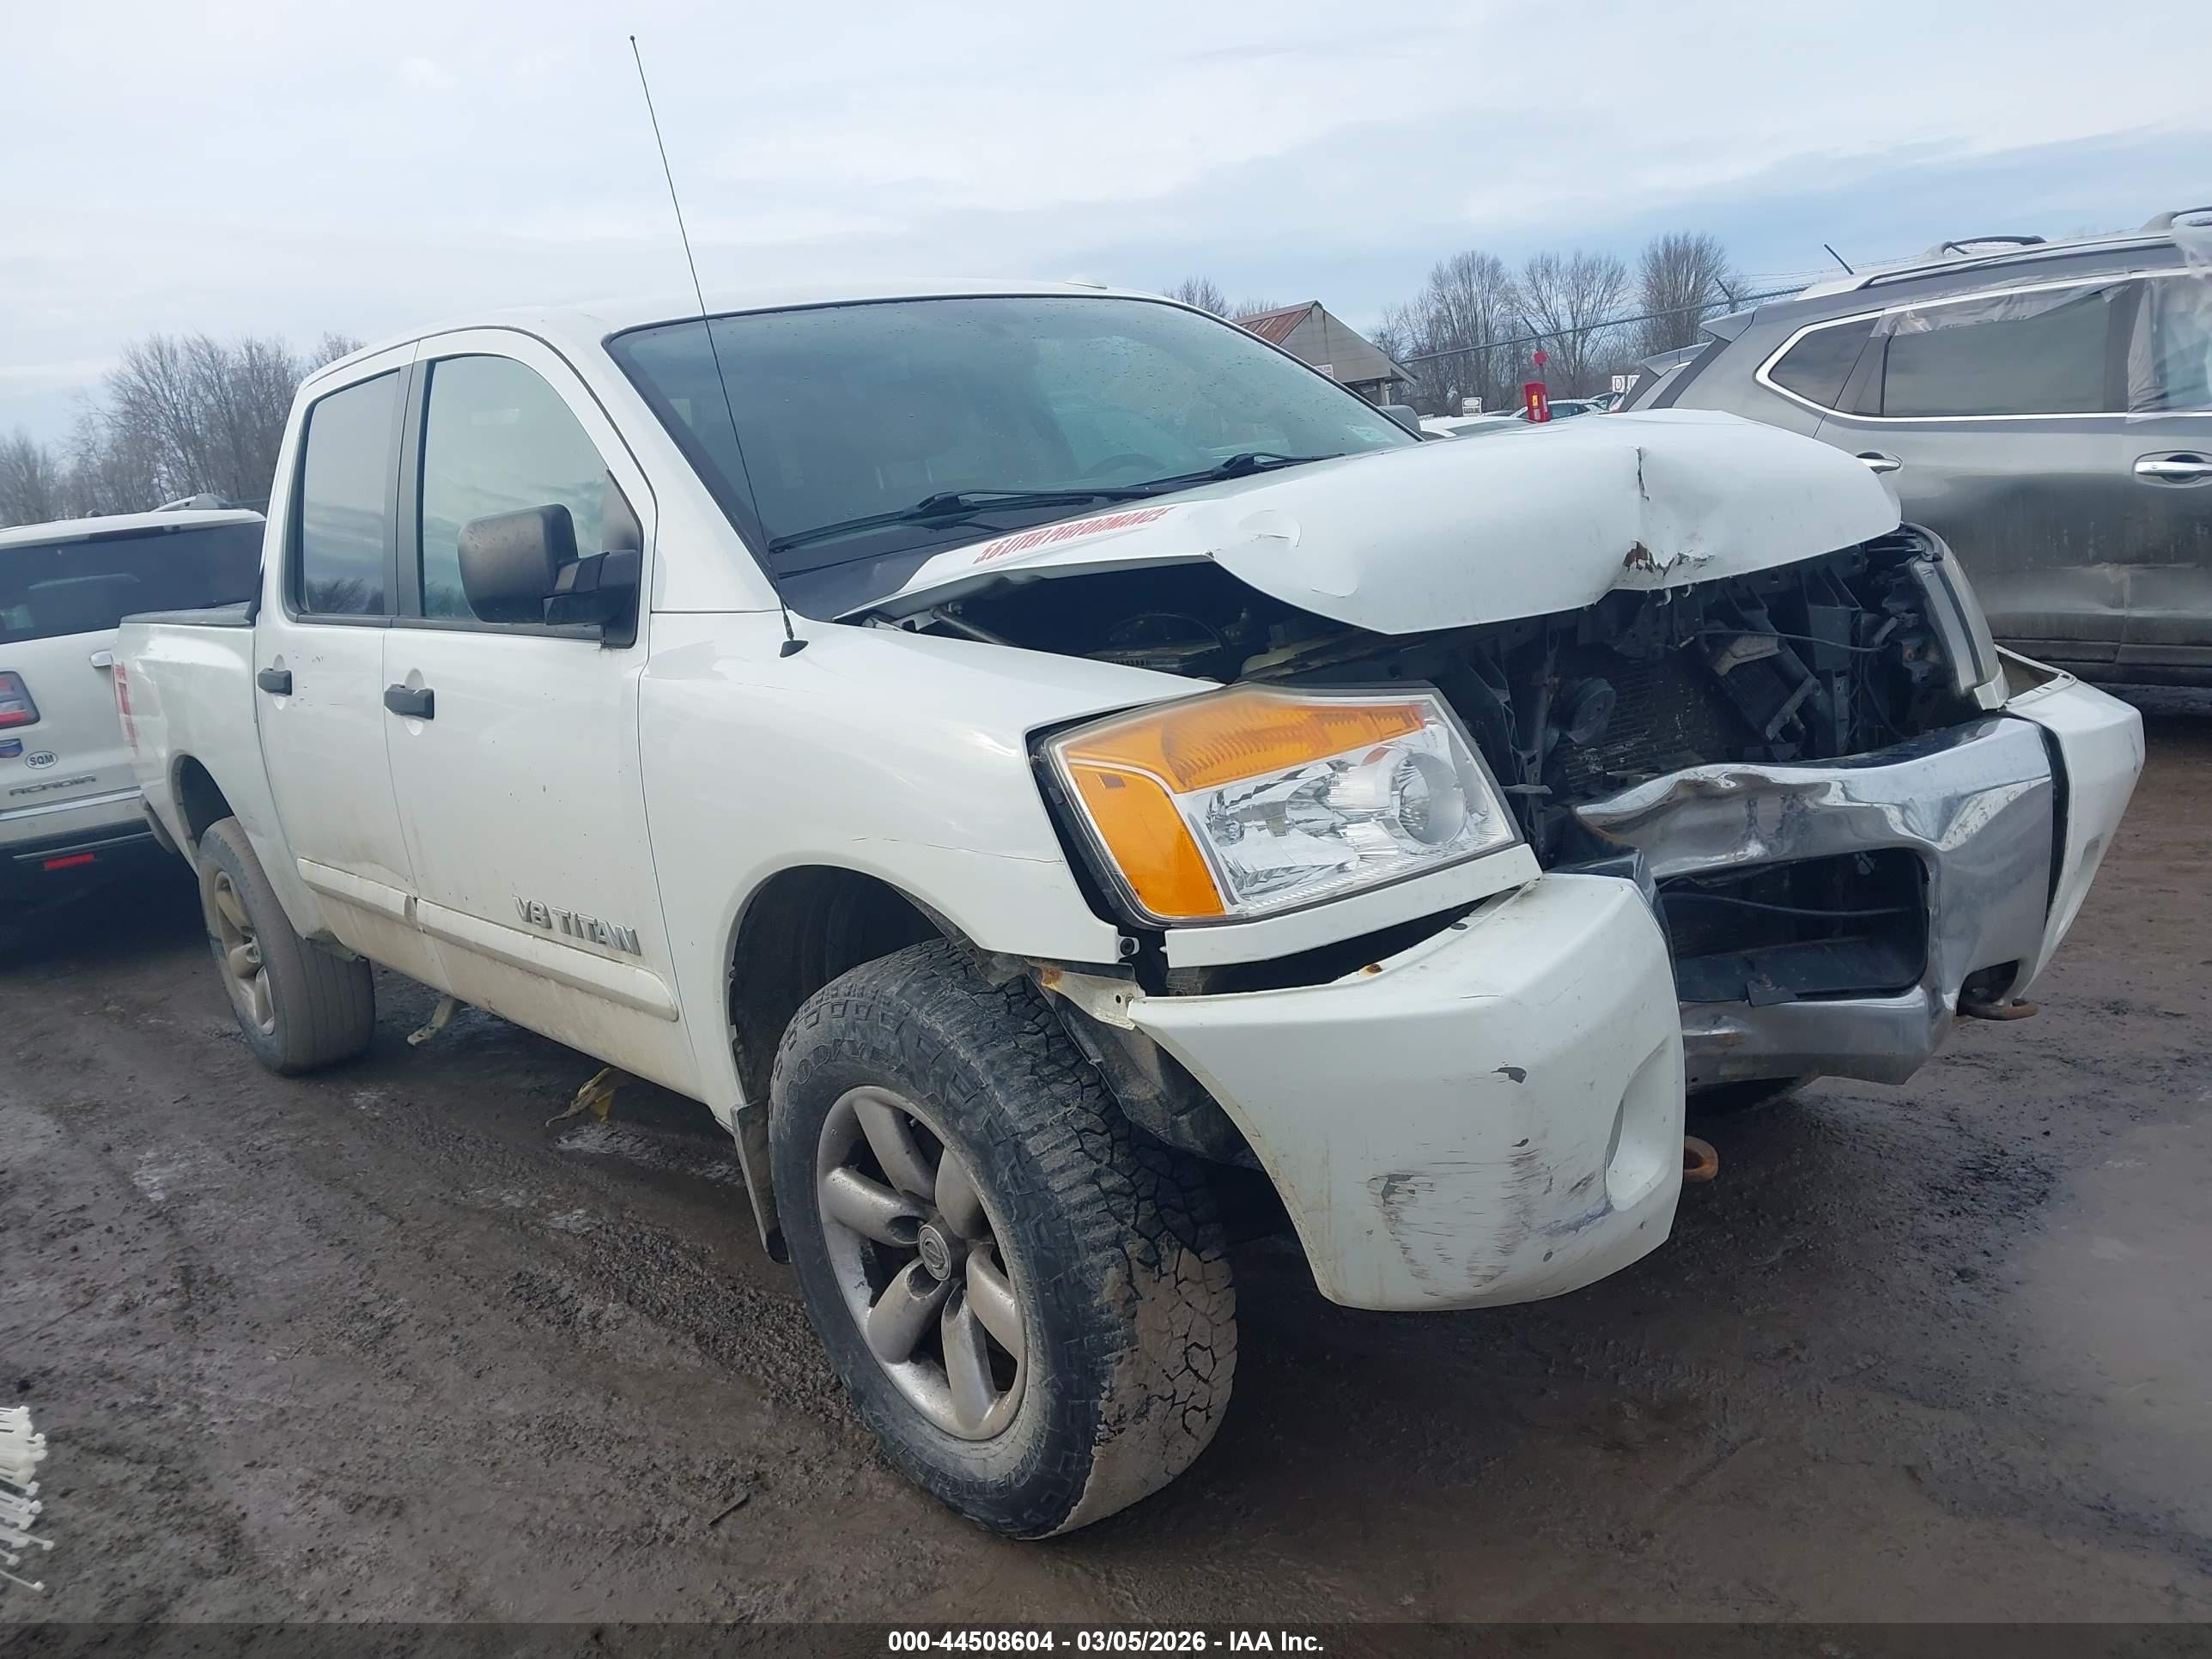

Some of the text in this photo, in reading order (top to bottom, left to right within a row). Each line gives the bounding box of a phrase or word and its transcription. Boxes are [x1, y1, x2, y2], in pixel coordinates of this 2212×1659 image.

[1040, 506, 1177, 545] PERFORMANCE
[29, 754, 55, 767] SQM
[512, 893, 642, 956] V8 TITAN
